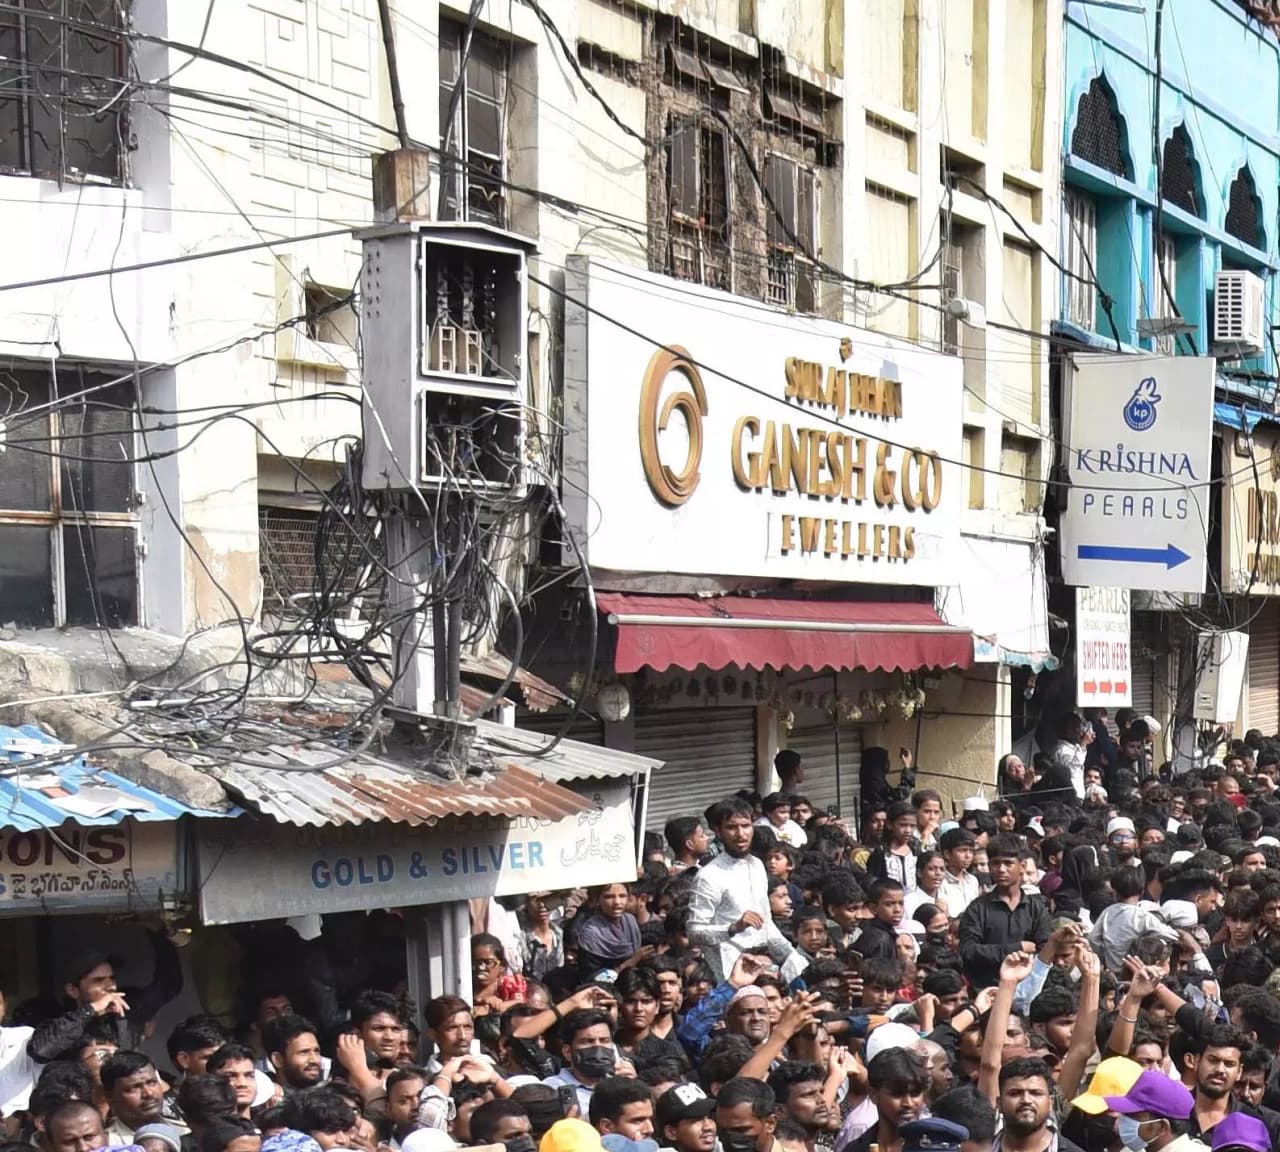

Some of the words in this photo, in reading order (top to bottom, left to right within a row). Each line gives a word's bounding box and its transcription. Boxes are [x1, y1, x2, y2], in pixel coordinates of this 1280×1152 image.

[731, 415, 867, 501] GANESH
[874, 442, 900, 507] &
[901, 447, 942, 512] CO
[1083, 493, 1188, 520] PEARLS
[1080, 587, 1128, 615] PEARLS
[1083, 640, 1110, 671] SHIFTED
[1112, 641, 1128, 671] HERE
[0, 828, 126, 867] ONS
[312, 853, 396, 889] GOLD
[408, 850, 429, 880] &
[442, 840, 545, 876] SILVER
